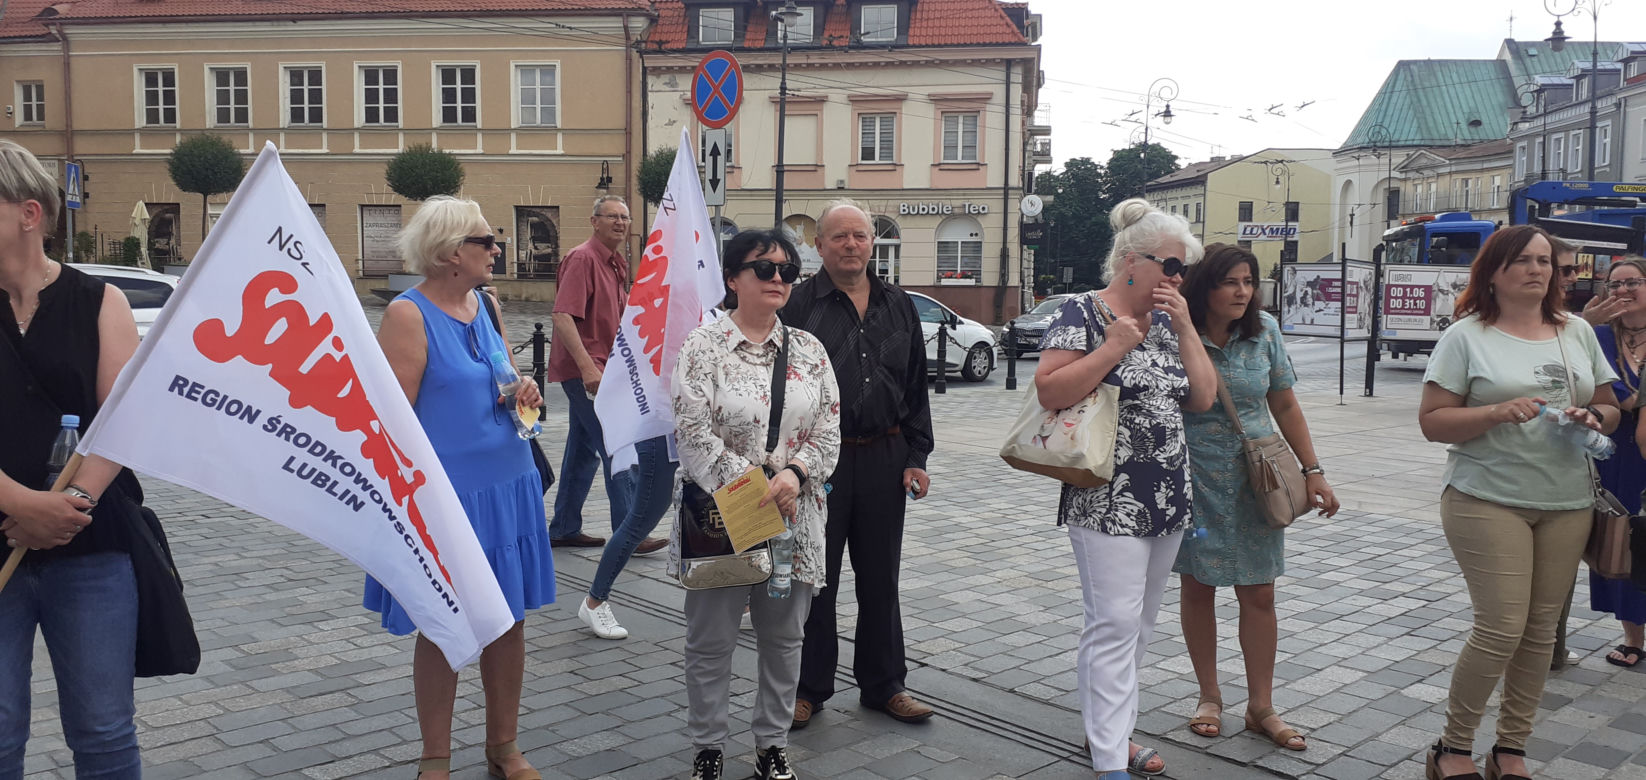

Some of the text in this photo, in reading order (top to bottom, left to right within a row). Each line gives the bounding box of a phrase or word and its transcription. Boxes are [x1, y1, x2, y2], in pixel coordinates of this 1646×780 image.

[900, 202, 988, 215] Bubble Tea
[1390, 287, 1425, 298] OD 1.06
[1389, 298, 1426, 309] DO 31.10
[281, 455, 366, 513] LUBLIN
[168, 373, 460, 615] REGION ŚRODKOWOWSCHODNI
